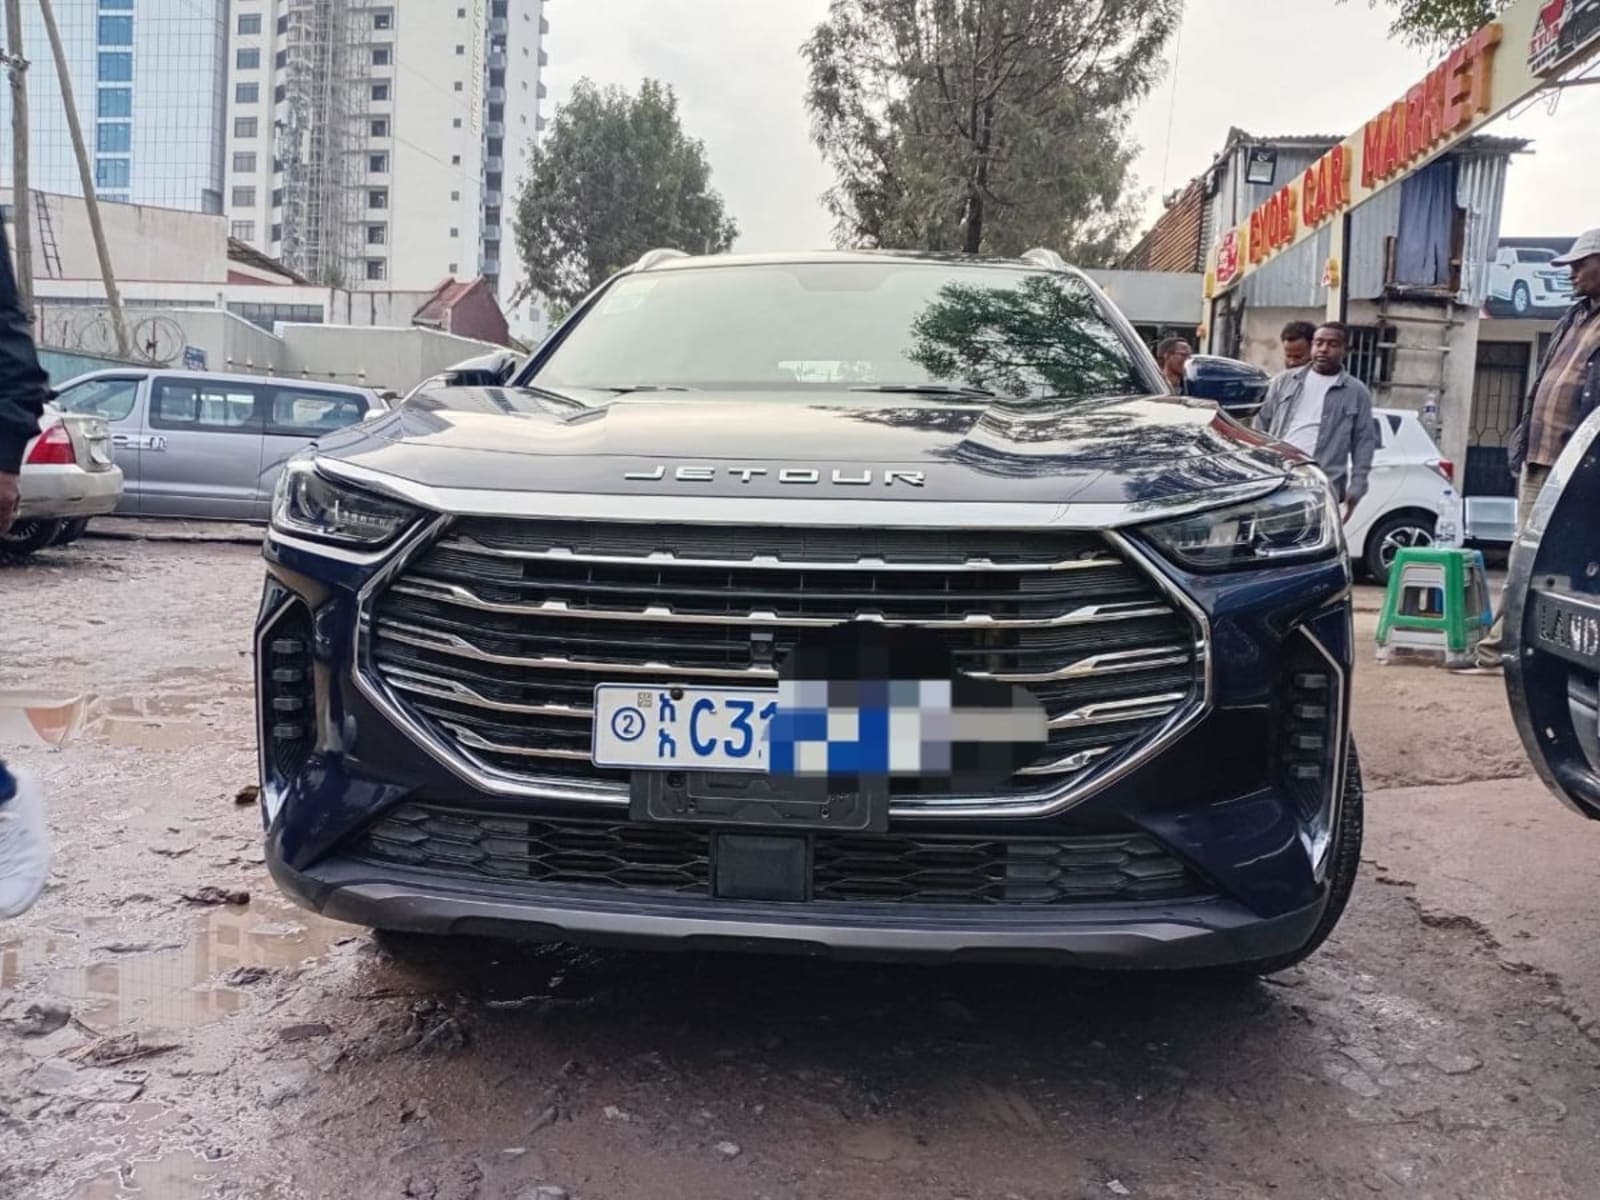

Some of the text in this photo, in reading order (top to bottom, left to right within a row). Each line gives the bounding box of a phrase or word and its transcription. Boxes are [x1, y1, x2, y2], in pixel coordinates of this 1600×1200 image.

[1303, 144, 1351, 228] CAR
[1362, 23, 1503, 189] MARKET
[624, 465, 926, 487] JETOUR
